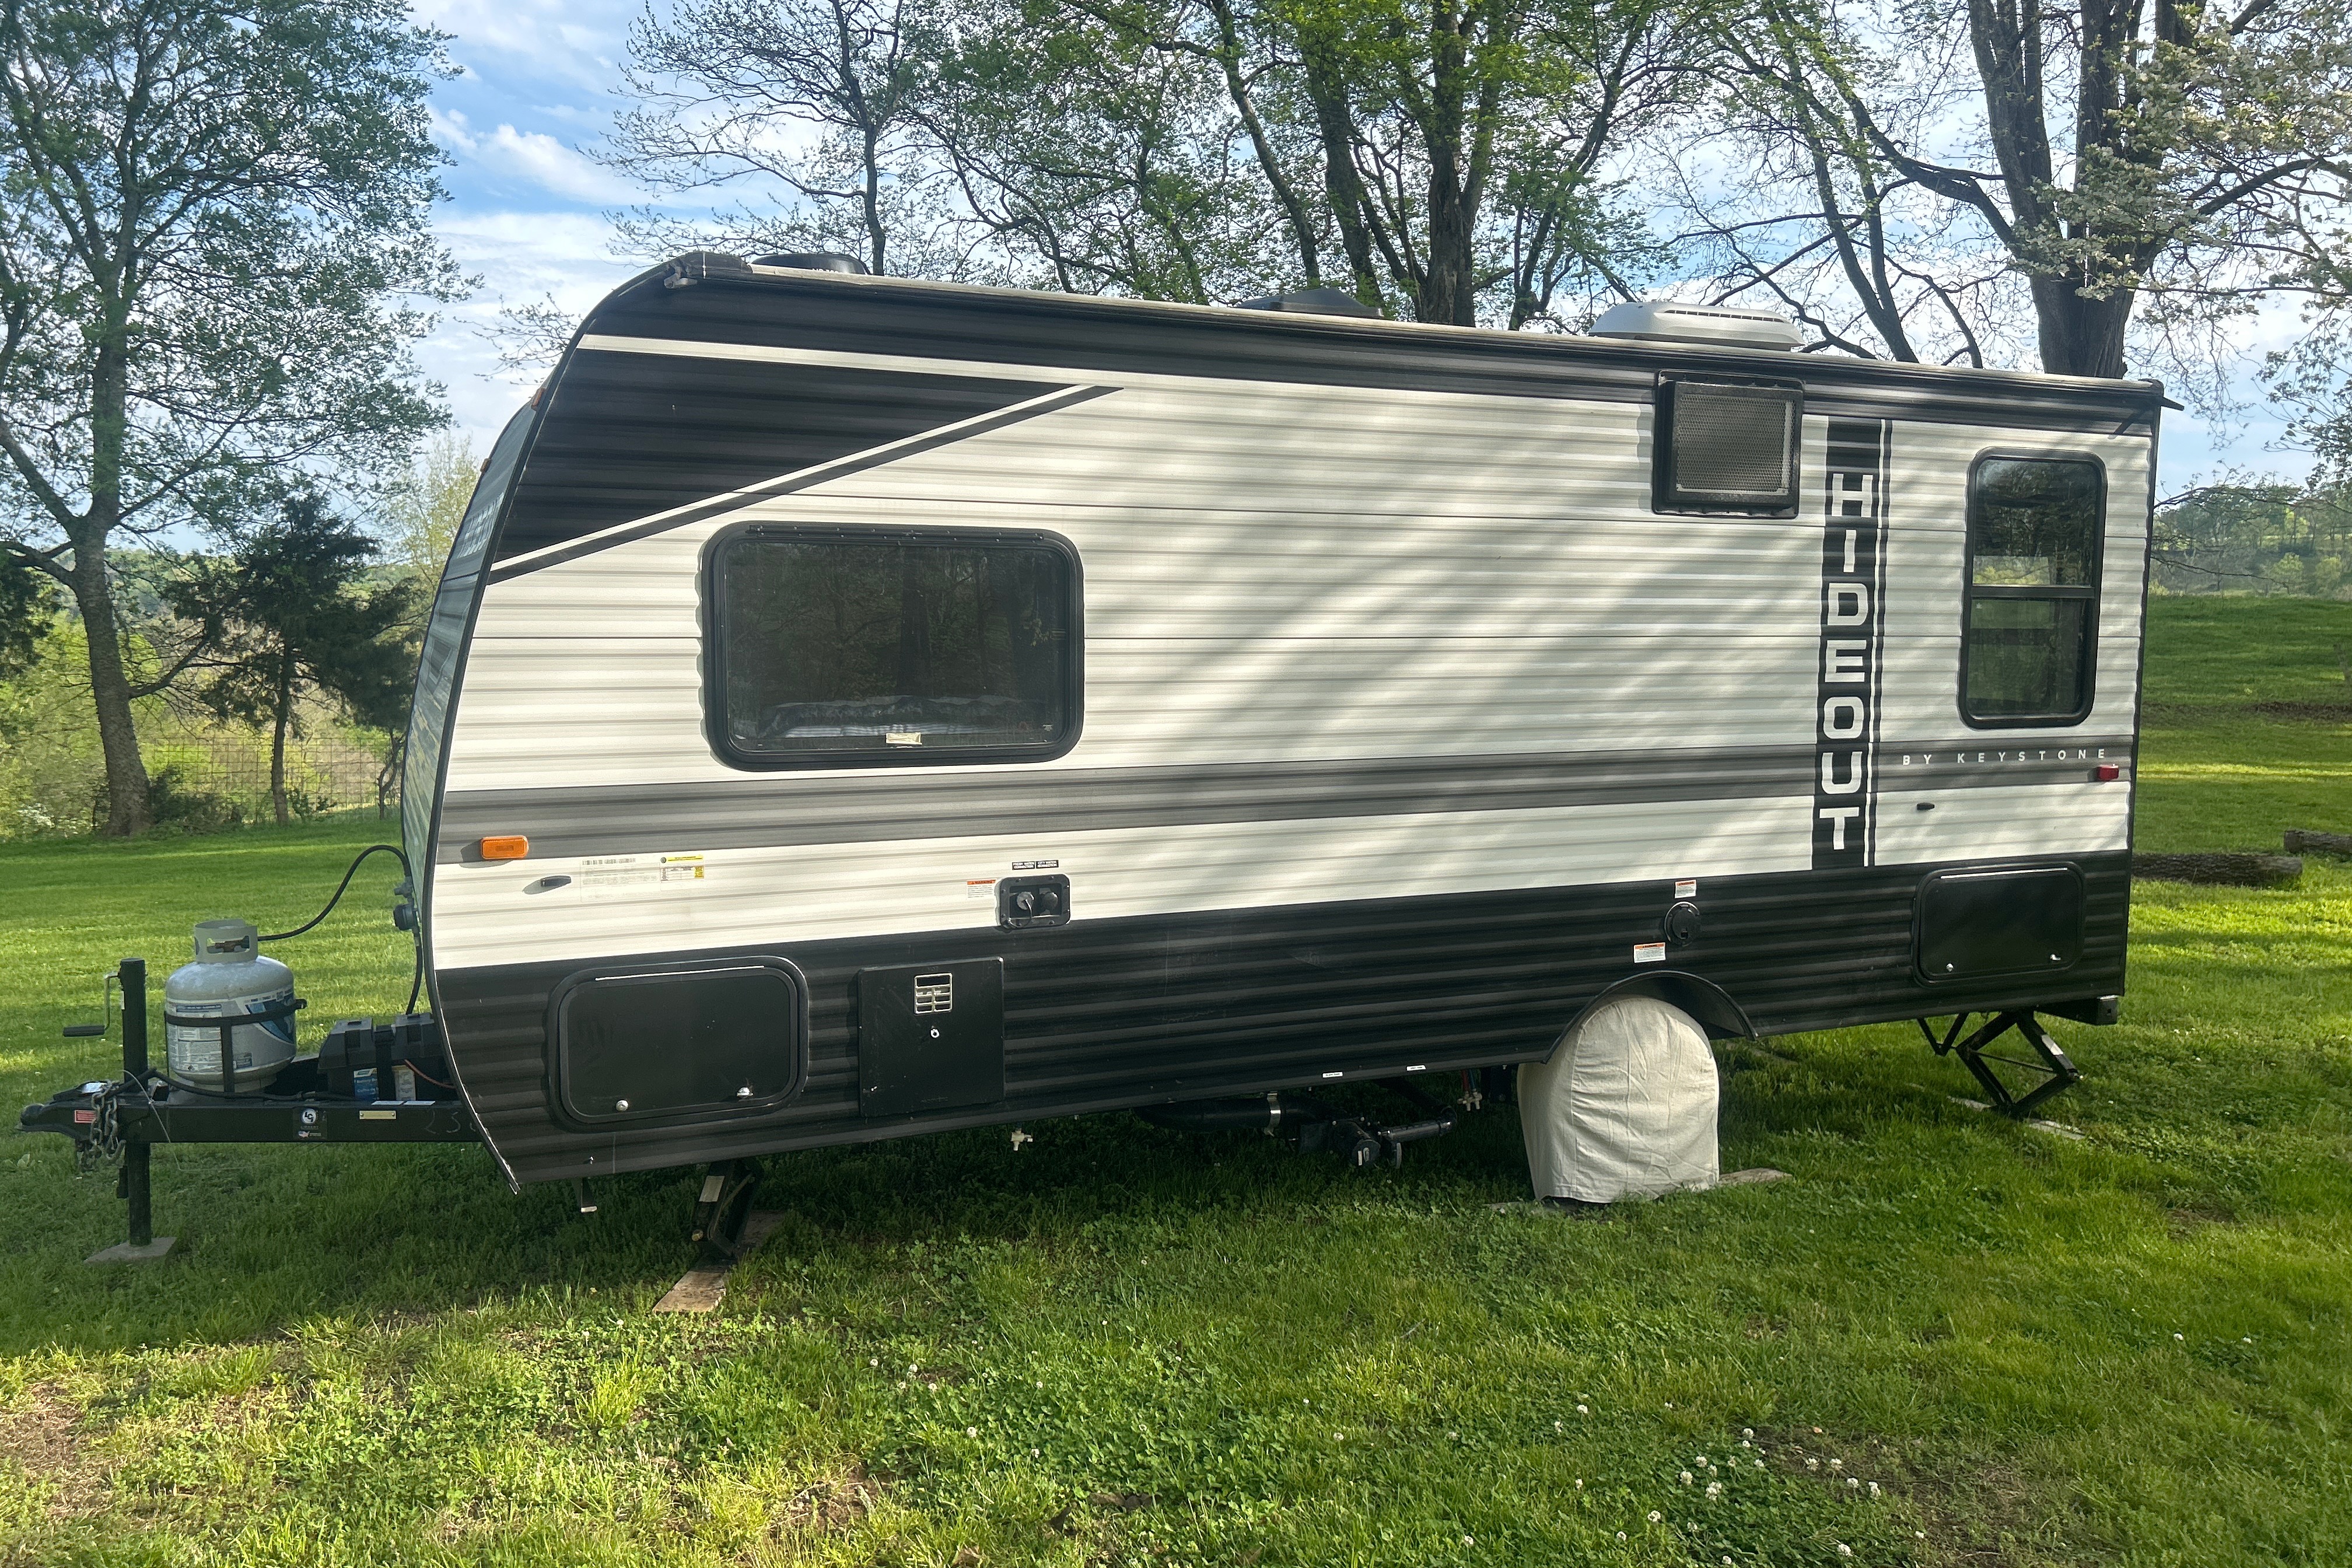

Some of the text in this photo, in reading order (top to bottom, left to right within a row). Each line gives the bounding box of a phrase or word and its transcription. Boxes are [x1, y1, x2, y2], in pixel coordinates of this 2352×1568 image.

[1819, 474, 1873, 849] HIDEOUT
[1903, 749, 2104, 765] BY KEYSTONE
